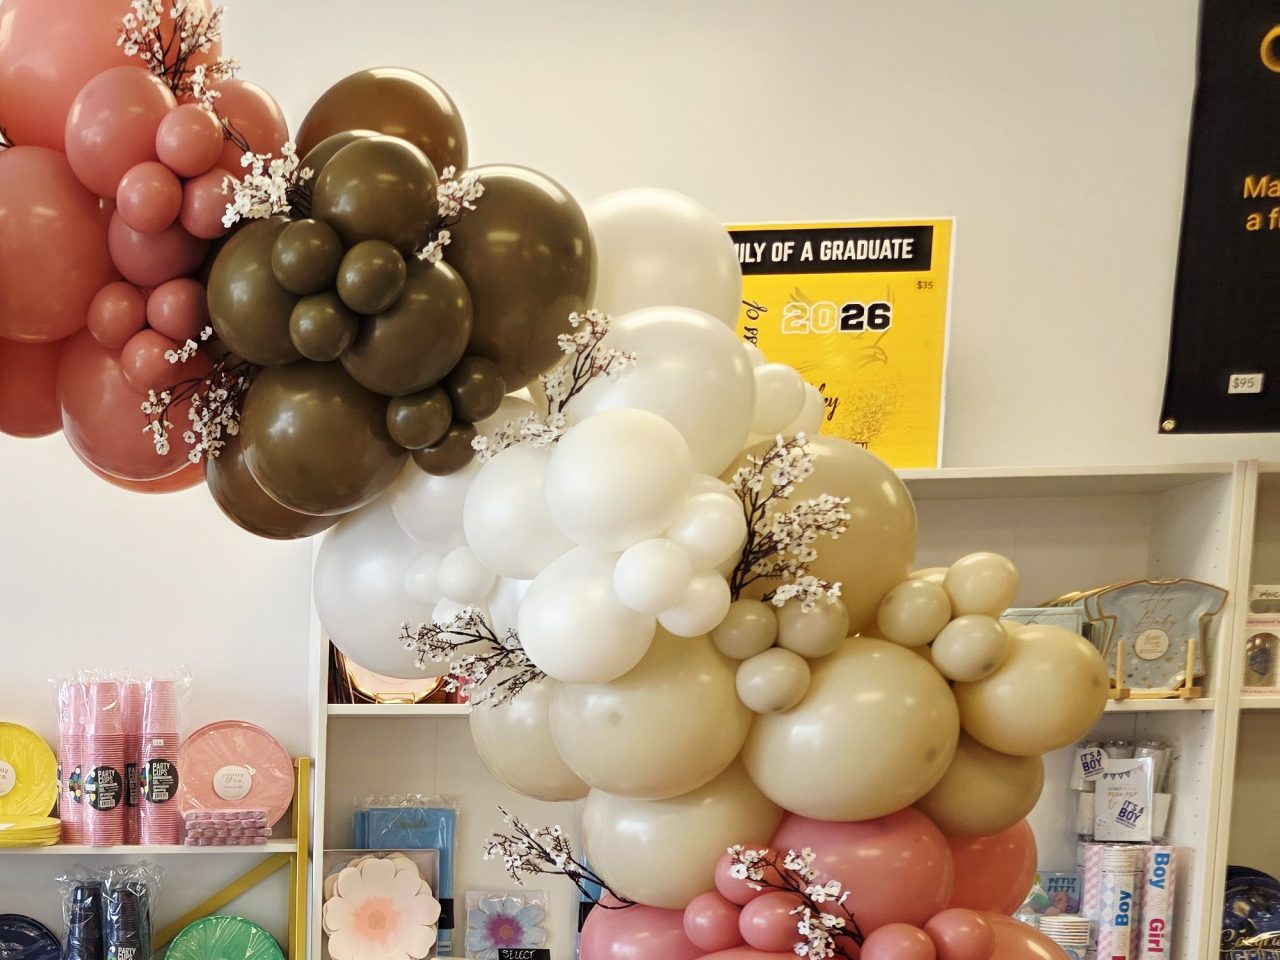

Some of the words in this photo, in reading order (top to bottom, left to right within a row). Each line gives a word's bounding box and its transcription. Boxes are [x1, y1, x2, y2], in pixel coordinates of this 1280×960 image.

[736, 242, 766, 262] ILY
[772, 242, 795, 262] OF
[800, 241, 814, 262] A
[820, 238, 914, 261] GRADUATE
[917, 280, 934, 290] $35
[782, 301, 892, 334] 2026
[1232, 376, 1255, 390] $95
[1080, 752, 1095, 762] IT'S
[1082, 757, 1102, 772] BOY
[1118, 807, 1141, 823] BOY
[1149, 853, 1170, 889] Boy
[1115, 890, 1131, 926] Boy
[1148, 918, 1165, 952] Girl
[118, 947, 136, 955] PARTY
[502, 950, 536, 960] SELECT
